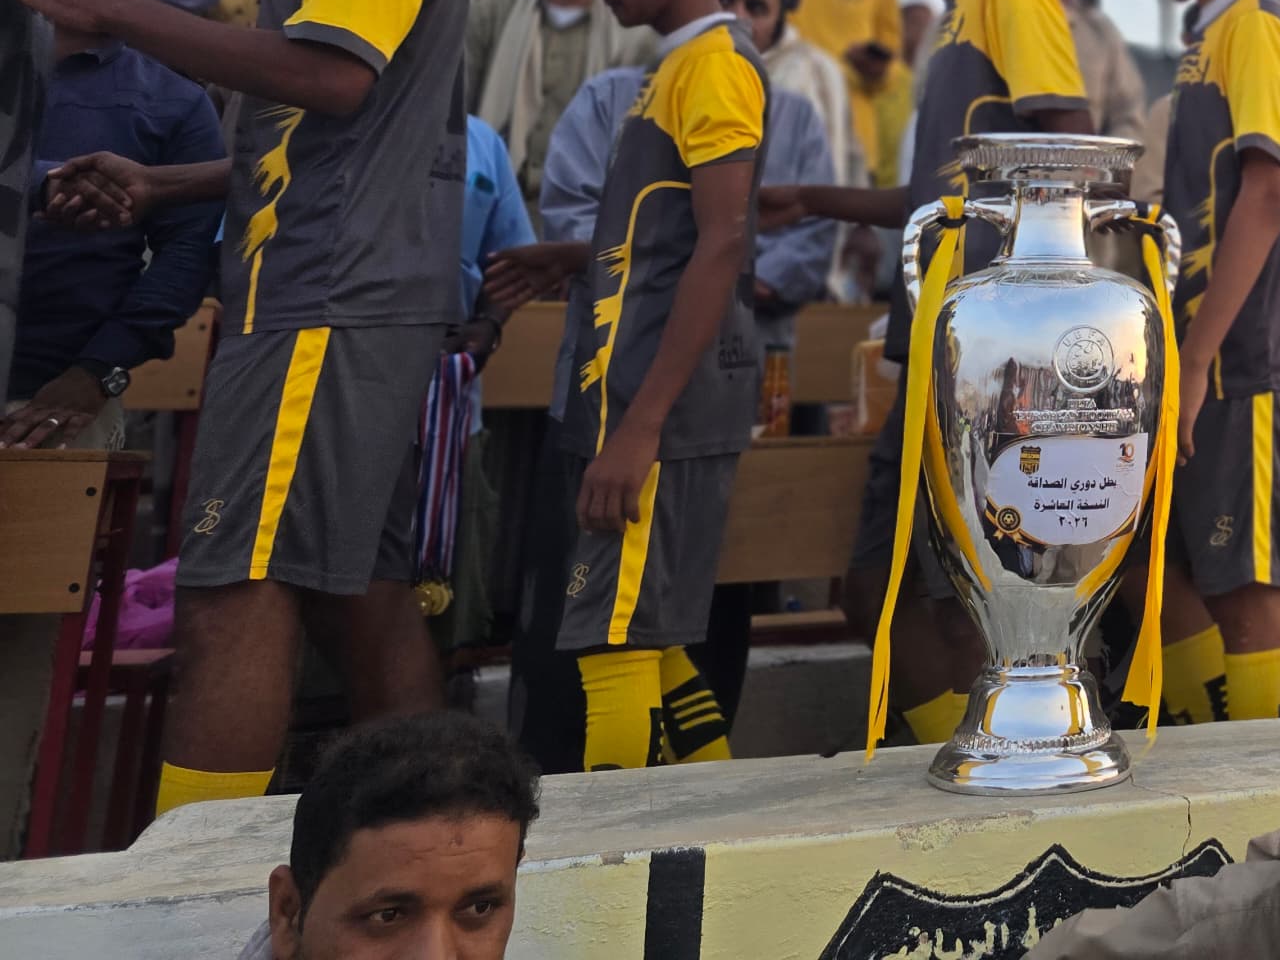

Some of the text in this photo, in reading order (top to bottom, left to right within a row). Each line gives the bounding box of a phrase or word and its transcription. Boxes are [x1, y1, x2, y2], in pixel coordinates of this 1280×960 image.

[1028, 476, 1117, 494] بطل دوري الصداقة
[1033, 498, 1110, 512] النسخة العاشرة
